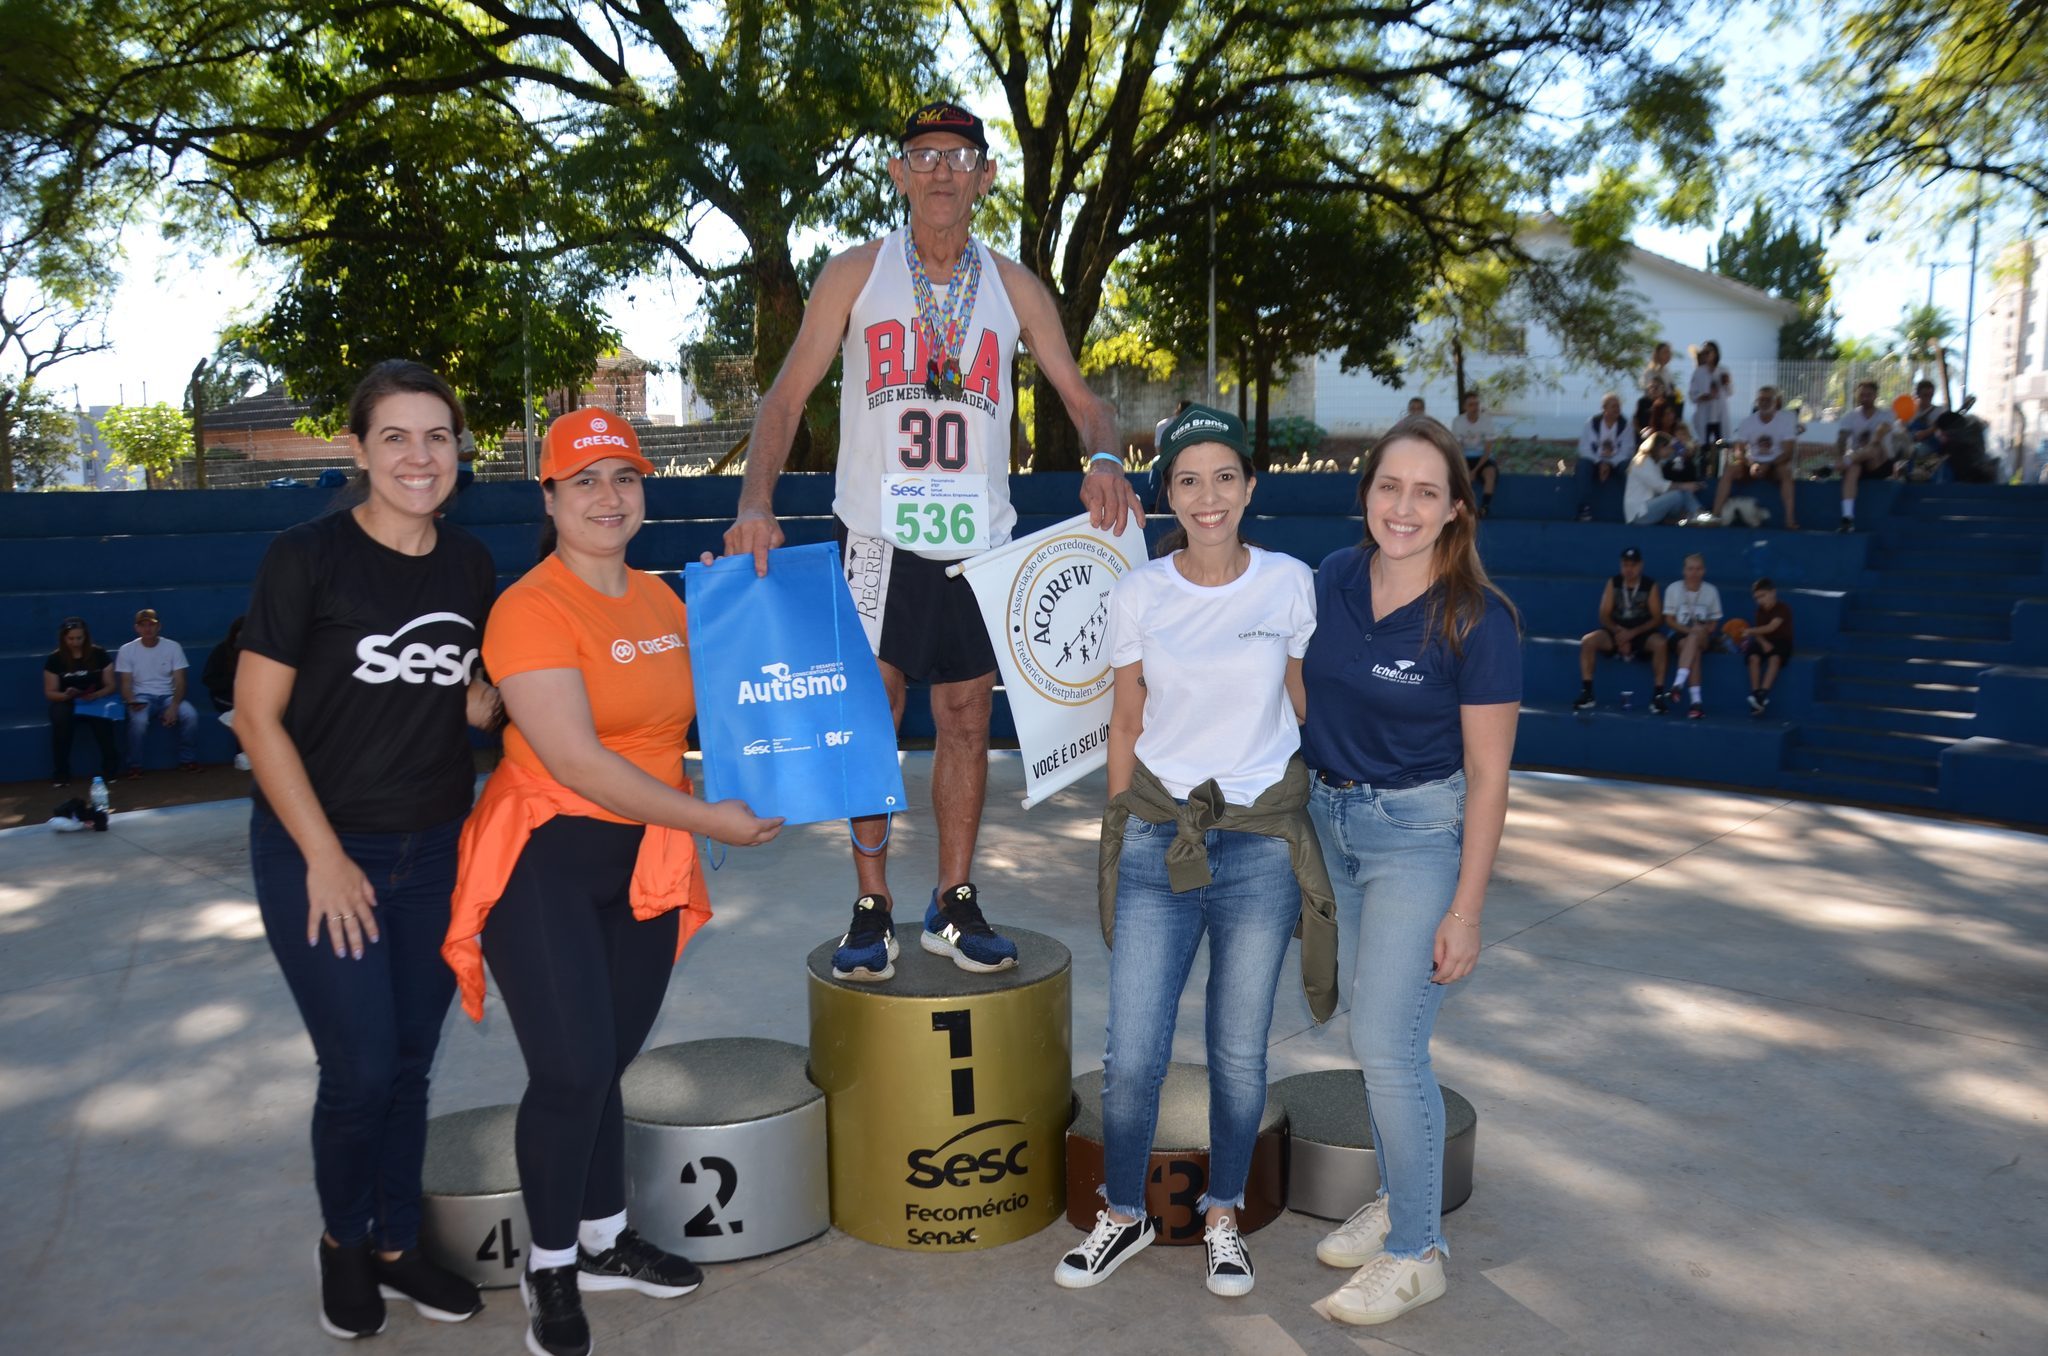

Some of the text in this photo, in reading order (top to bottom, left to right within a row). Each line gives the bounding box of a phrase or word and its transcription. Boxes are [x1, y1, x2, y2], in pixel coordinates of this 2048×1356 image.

[864, 318, 1000, 405] RMA
[868, 389, 894, 410] REDE
[896, 387, 943, 400] MEST
[573, 435, 629, 450] CRESOL
[898, 408, 968, 472] 30
[1171, 418, 1229, 440] Casa Branca
[890, 478, 926, 497] Sesc
[895, 503, 976, 545] 536
[1012, 539, 1123, 616] Associação de Corredores de Rua
[1034, 565, 1093, 646] ACORFW
[638, 633, 685, 654] CRESOL
[1015, 640, 1044, 685] Frederico
[738, 674, 847, 704] Autismo
[1033, 749, 1060, 779] VOCÊ
[1061, 744, 1068, 764] É
[1070, 743, 1077, 759] O
[1079, 731, 1098, 754] SEU
[932, 1009, 975, 1117] 1
[905, 1119, 1029, 1190] Sesc
[680, 1156, 744, 1238] 2
[905, 1193, 1029, 1222] Fecomércio
[1151, 1160, 1207, 1240] 3
[476, 1218, 521, 1270] 4
[907, 1227, 977, 1246] Senac
